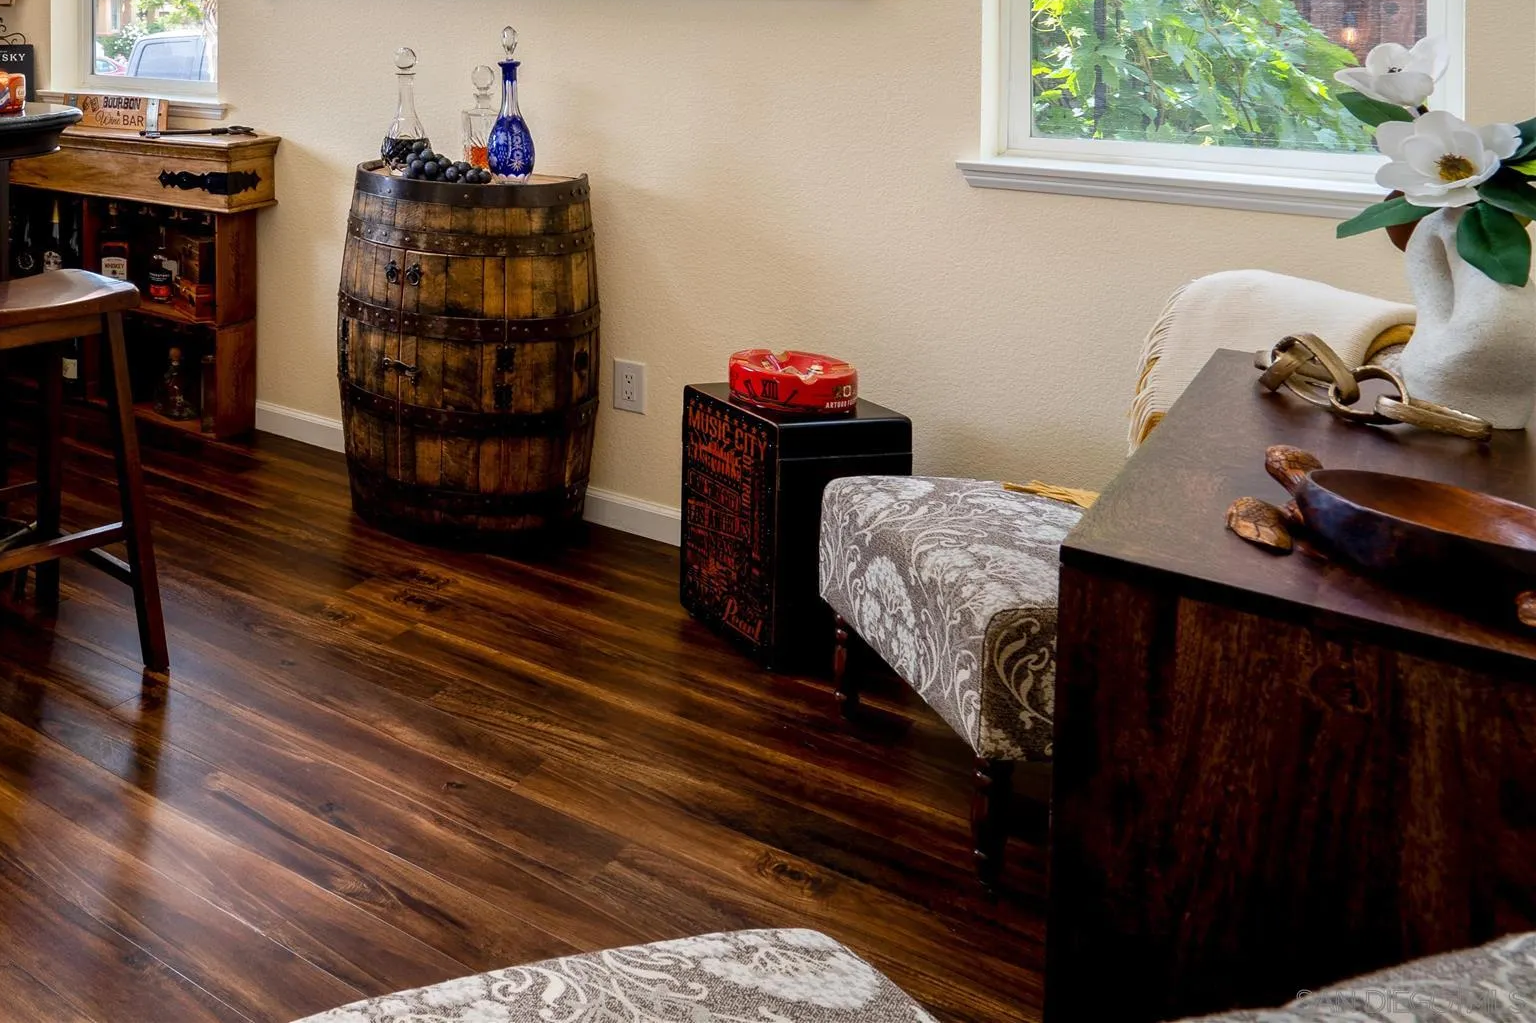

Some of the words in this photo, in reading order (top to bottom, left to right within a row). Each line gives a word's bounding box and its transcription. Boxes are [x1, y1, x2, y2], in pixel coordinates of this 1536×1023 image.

[103, 96, 141, 110] BOURBON
[95, 109, 121, 126] Wine
[122, 115, 144, 126] BAR
[688, 406, 731, 445] MUSIC
[735, 427, 768, 462] CITY
